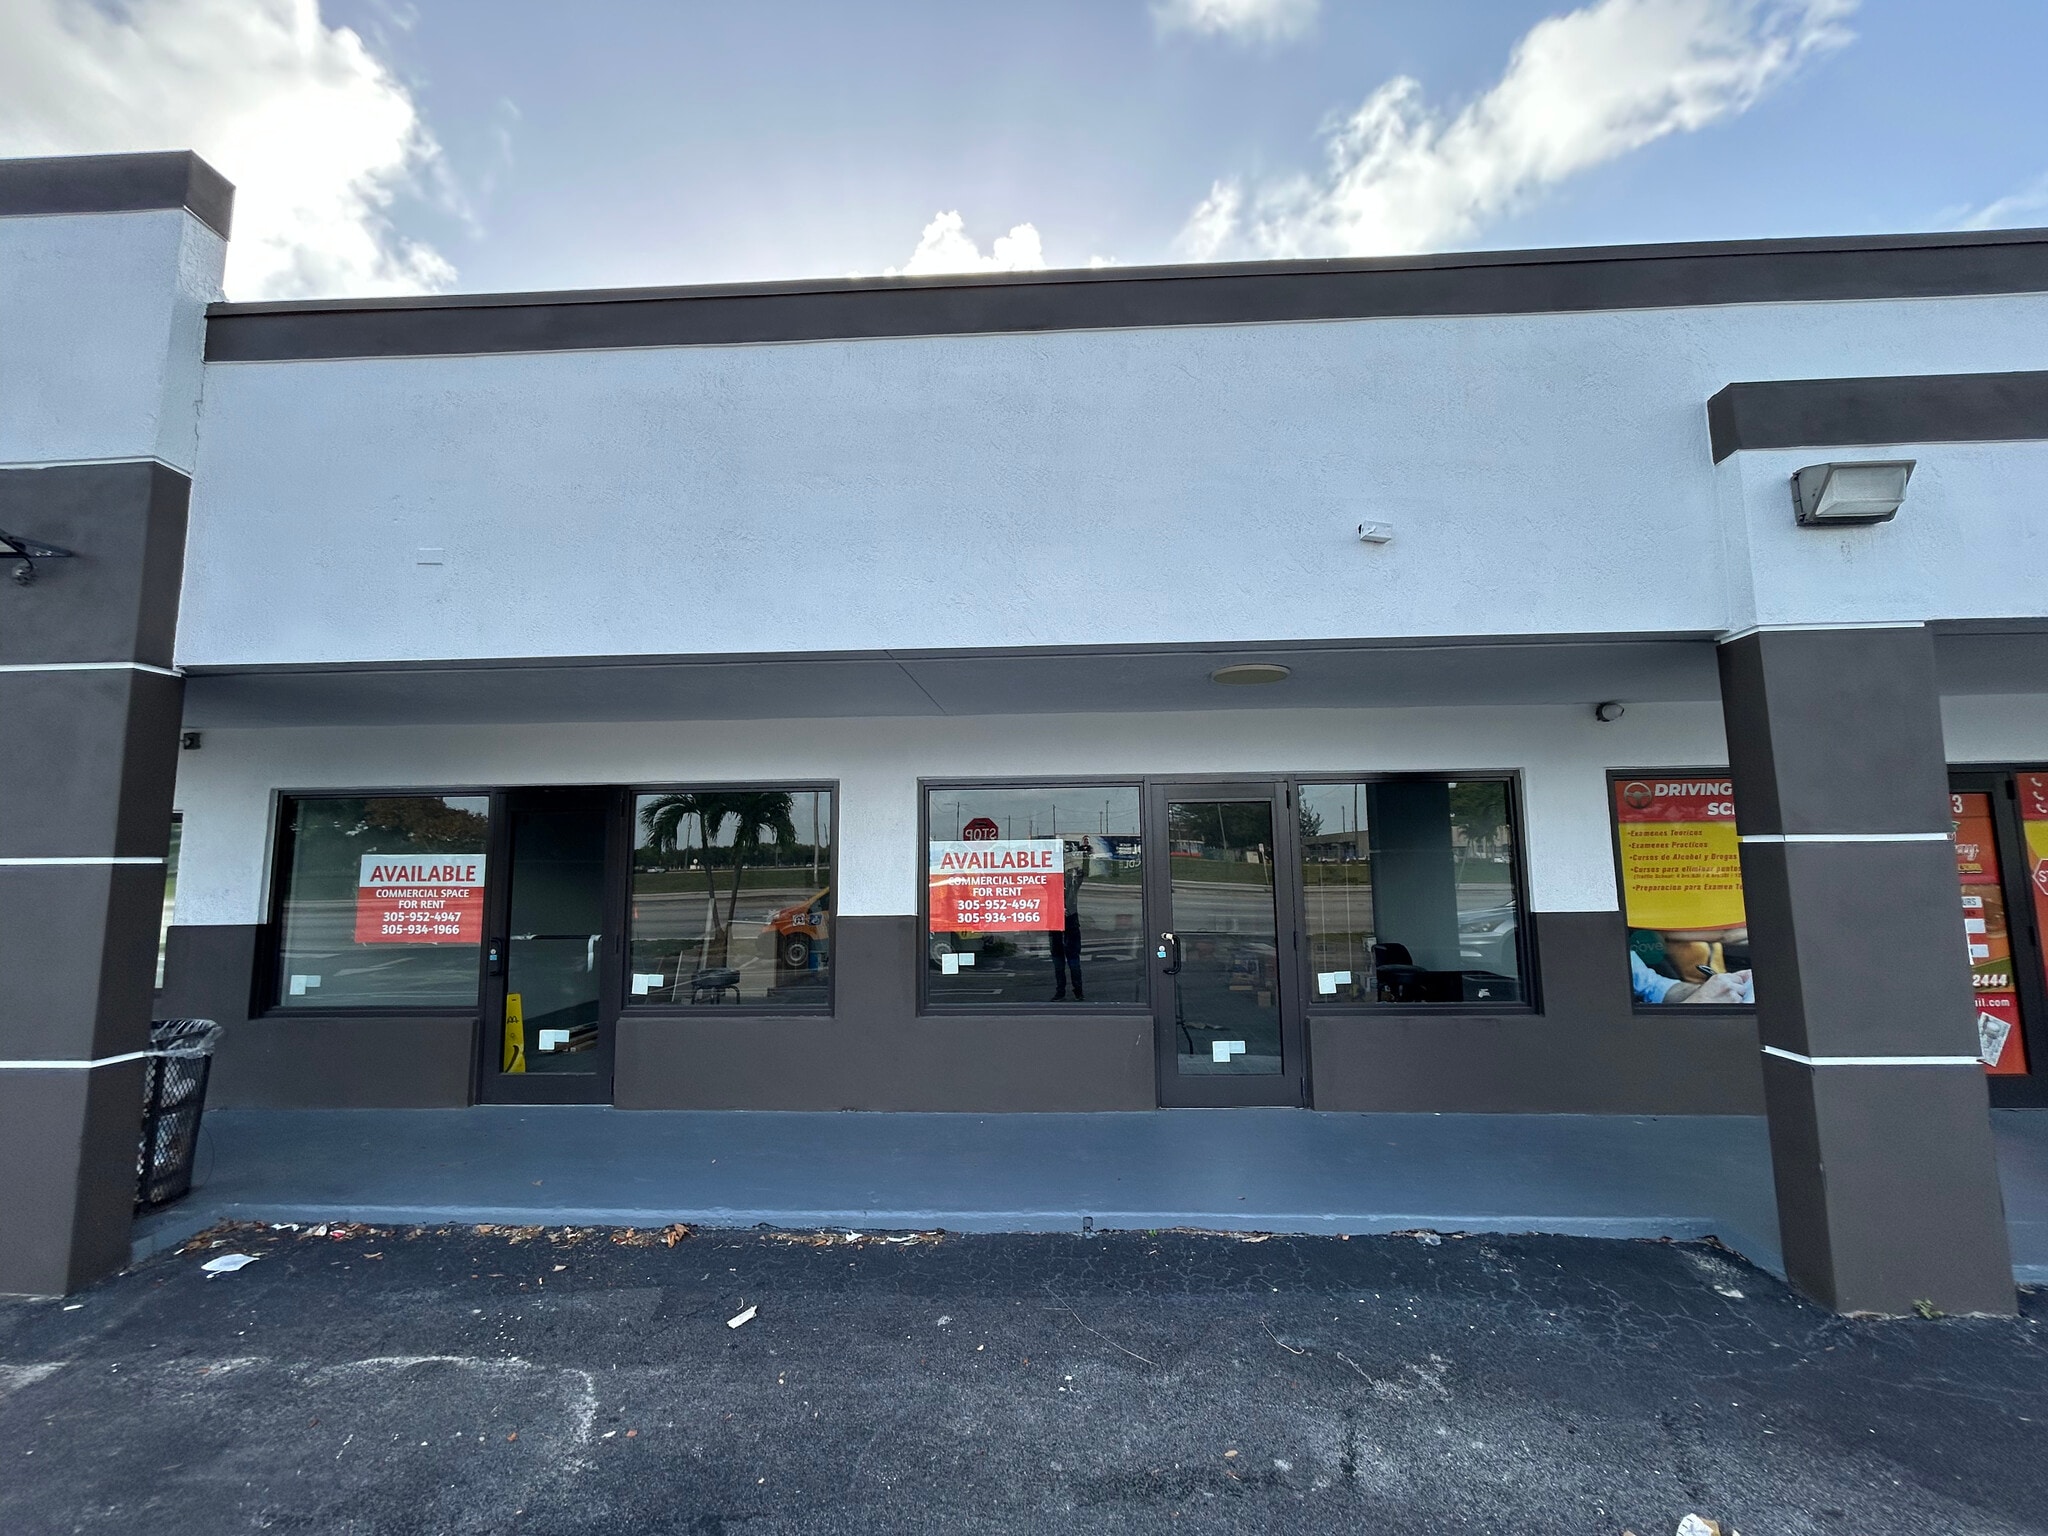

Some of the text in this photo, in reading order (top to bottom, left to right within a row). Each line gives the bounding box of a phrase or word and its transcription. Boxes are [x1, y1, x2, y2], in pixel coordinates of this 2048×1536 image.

[1654, 782, 1733, 796] DRIVING
[1707, 802, 1735, 815] SC
[1952, 794, 1963, 813] 3
[940, 851, 1053, 869] AVAILABLE
[1711, 853, 1738, 862] Drogas
[369, 865, 477, 882] AVAILABLE
[948, 875, 1047, 886] COMMERCIAL SPACE
[376, 889, 470, 898] COMMERCIAL SPACE
[972, 887, 1023, 897] FOR RENT
[398, 900, 446, 909] FOR RENT
[957, 899, 1041, 910] 305-952-4947
[383, 912, 462, 922] 305-952-4947
[957, 912, 1041, 923] 305-934-1966
[381, 925, 460, 935] 305-934-1966
[1972, 974, 2008, 987] 2444
